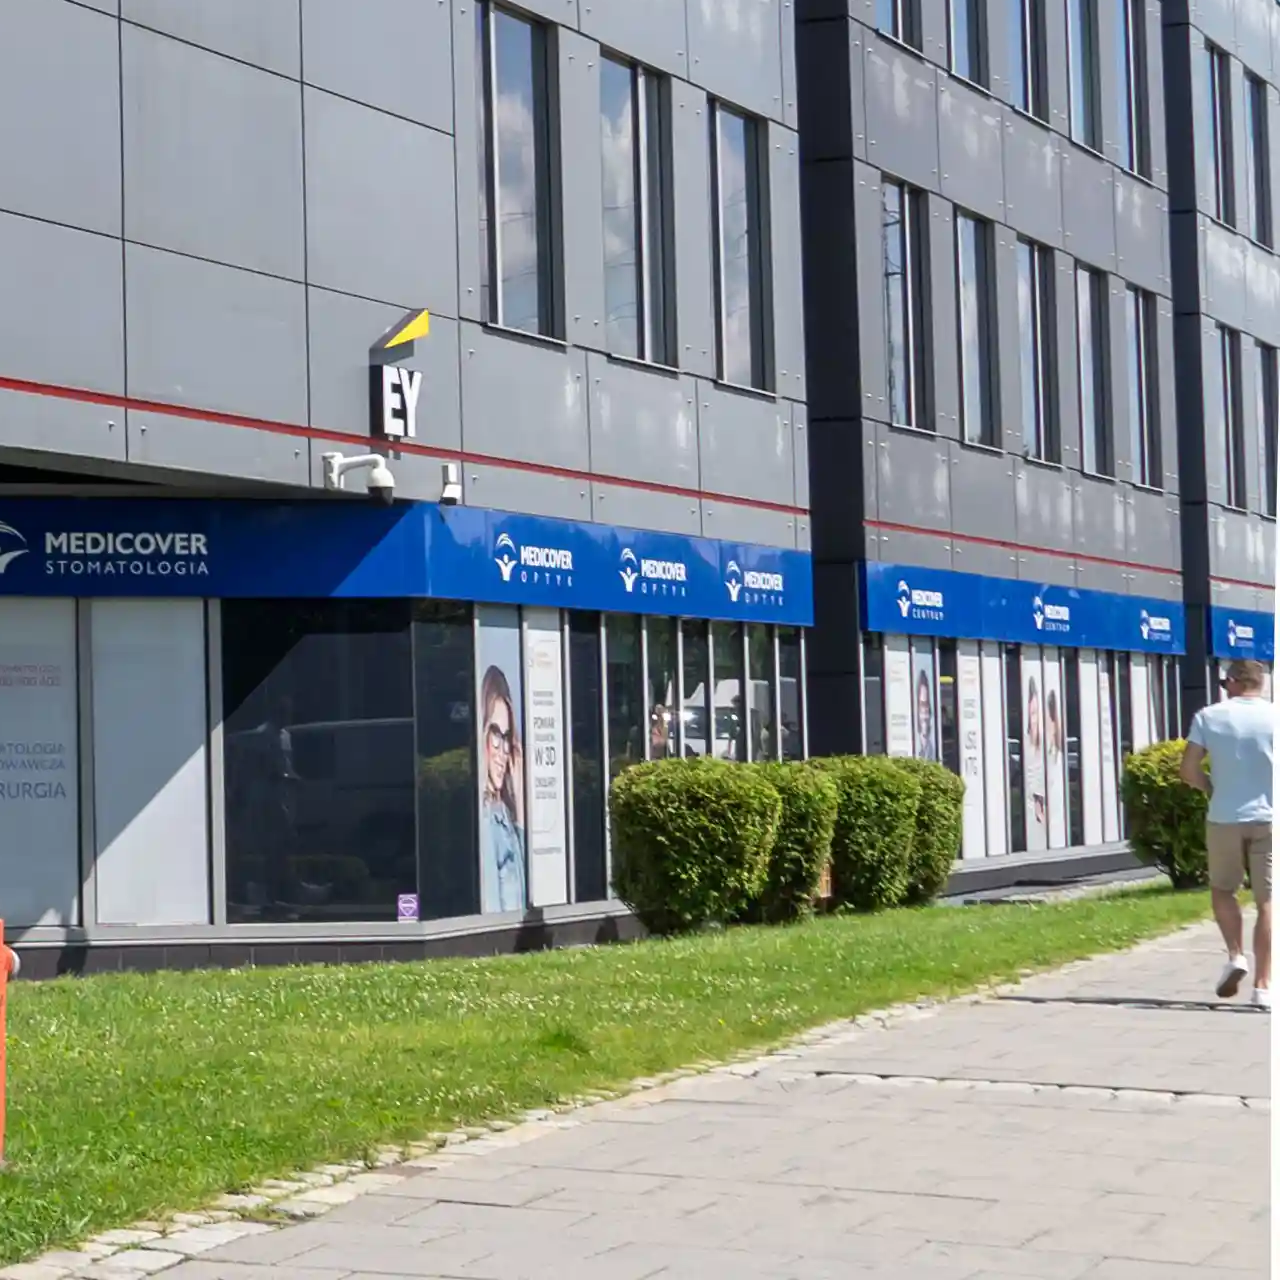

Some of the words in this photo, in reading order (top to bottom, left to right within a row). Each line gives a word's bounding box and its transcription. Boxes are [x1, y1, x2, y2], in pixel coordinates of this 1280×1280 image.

[382, 364, 423, 437] EY
[44, 532, 208, 555] MEDICOVER
[45, 560, 209, 575] STOMATOLOGIA
[520, 545, 573, 570] MEDICOVER
[641, 559, 687, 581] MEDICOVER
[743, 571, 784, 592] MEDICOVER
